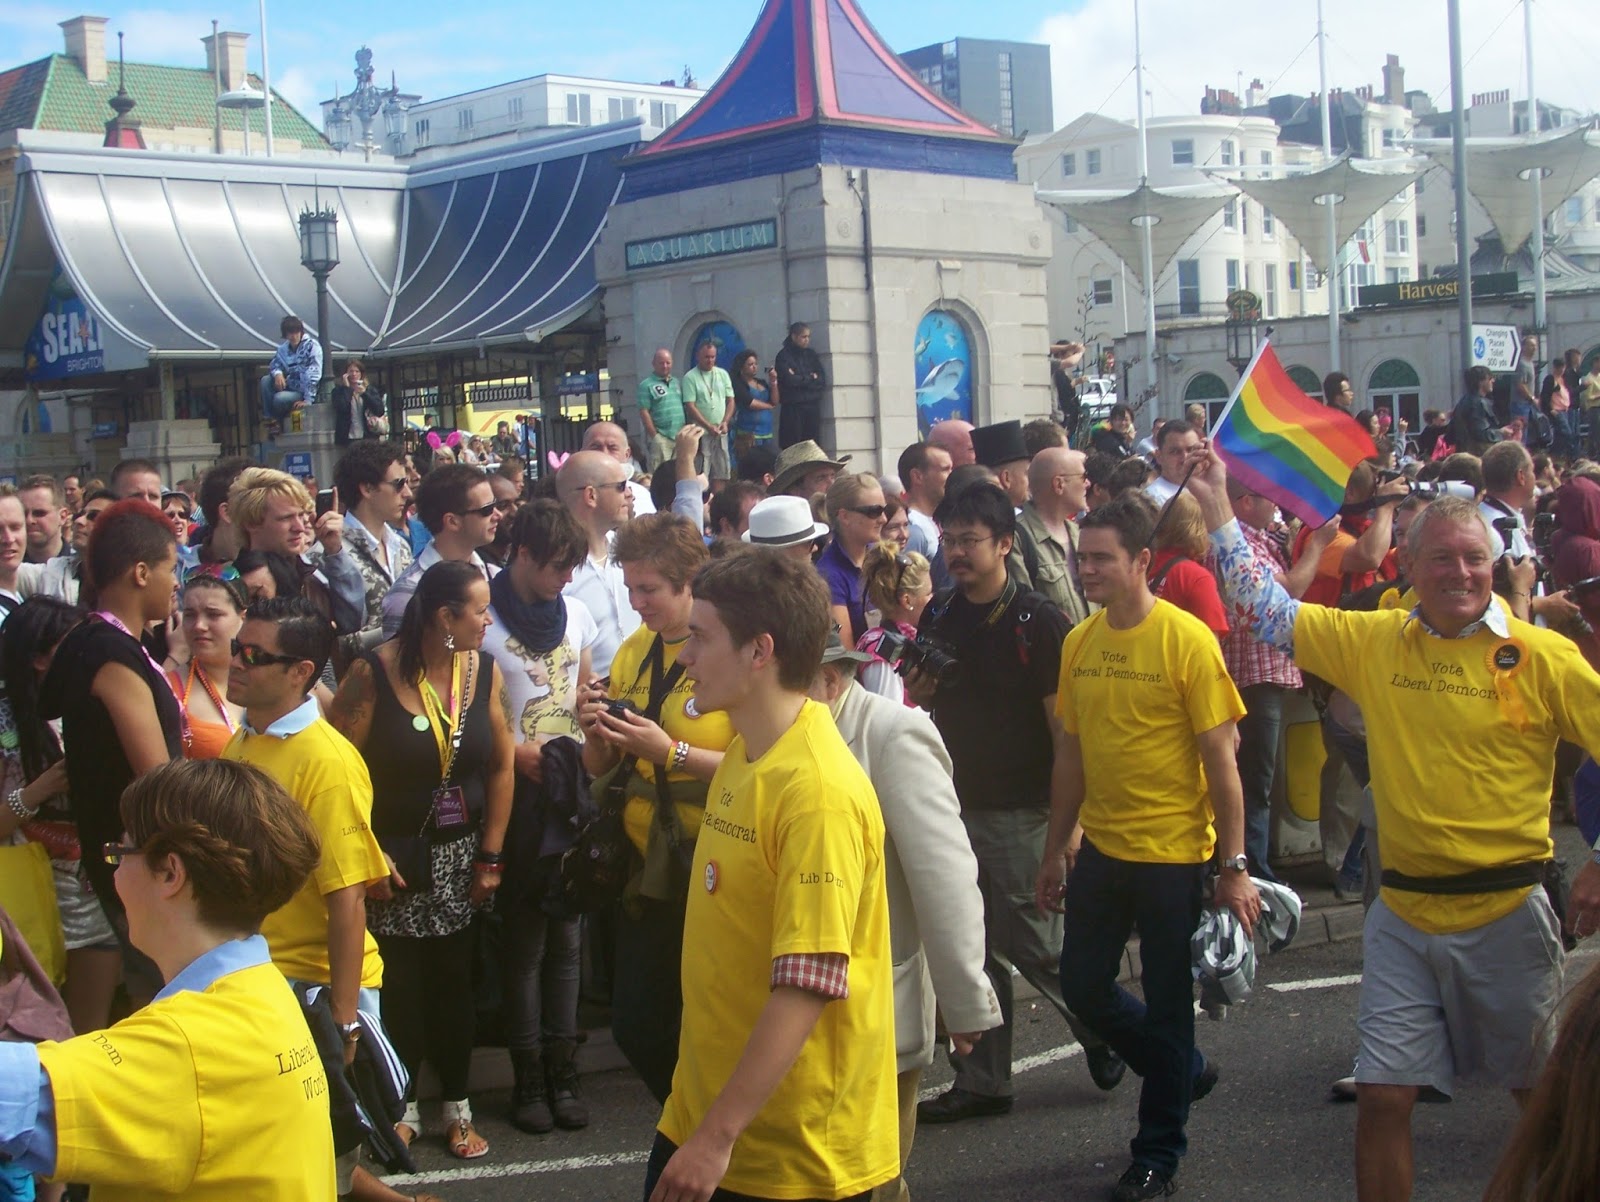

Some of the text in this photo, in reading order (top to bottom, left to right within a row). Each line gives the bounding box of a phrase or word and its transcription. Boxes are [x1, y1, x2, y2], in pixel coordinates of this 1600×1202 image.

[635, 223, 768, 265] AQUARIUM
[1399, 280, 1459, 300] Harvest
[1486, 328, 1508, 339] Changing
[1101, 651, 1128, 665] Vote
[1072, 665, 1162, 684] iberal Democrat
[1431, 661, 1465, 677] Vote
[1390, 673, 1433, 692] Liberal
[341, 825, 358, 837] Lib
[713, 816, 758, 845] emocrat
[799, 871, 846, 889] Lib Dm
[92, 1033, 123, 1067] Dem
